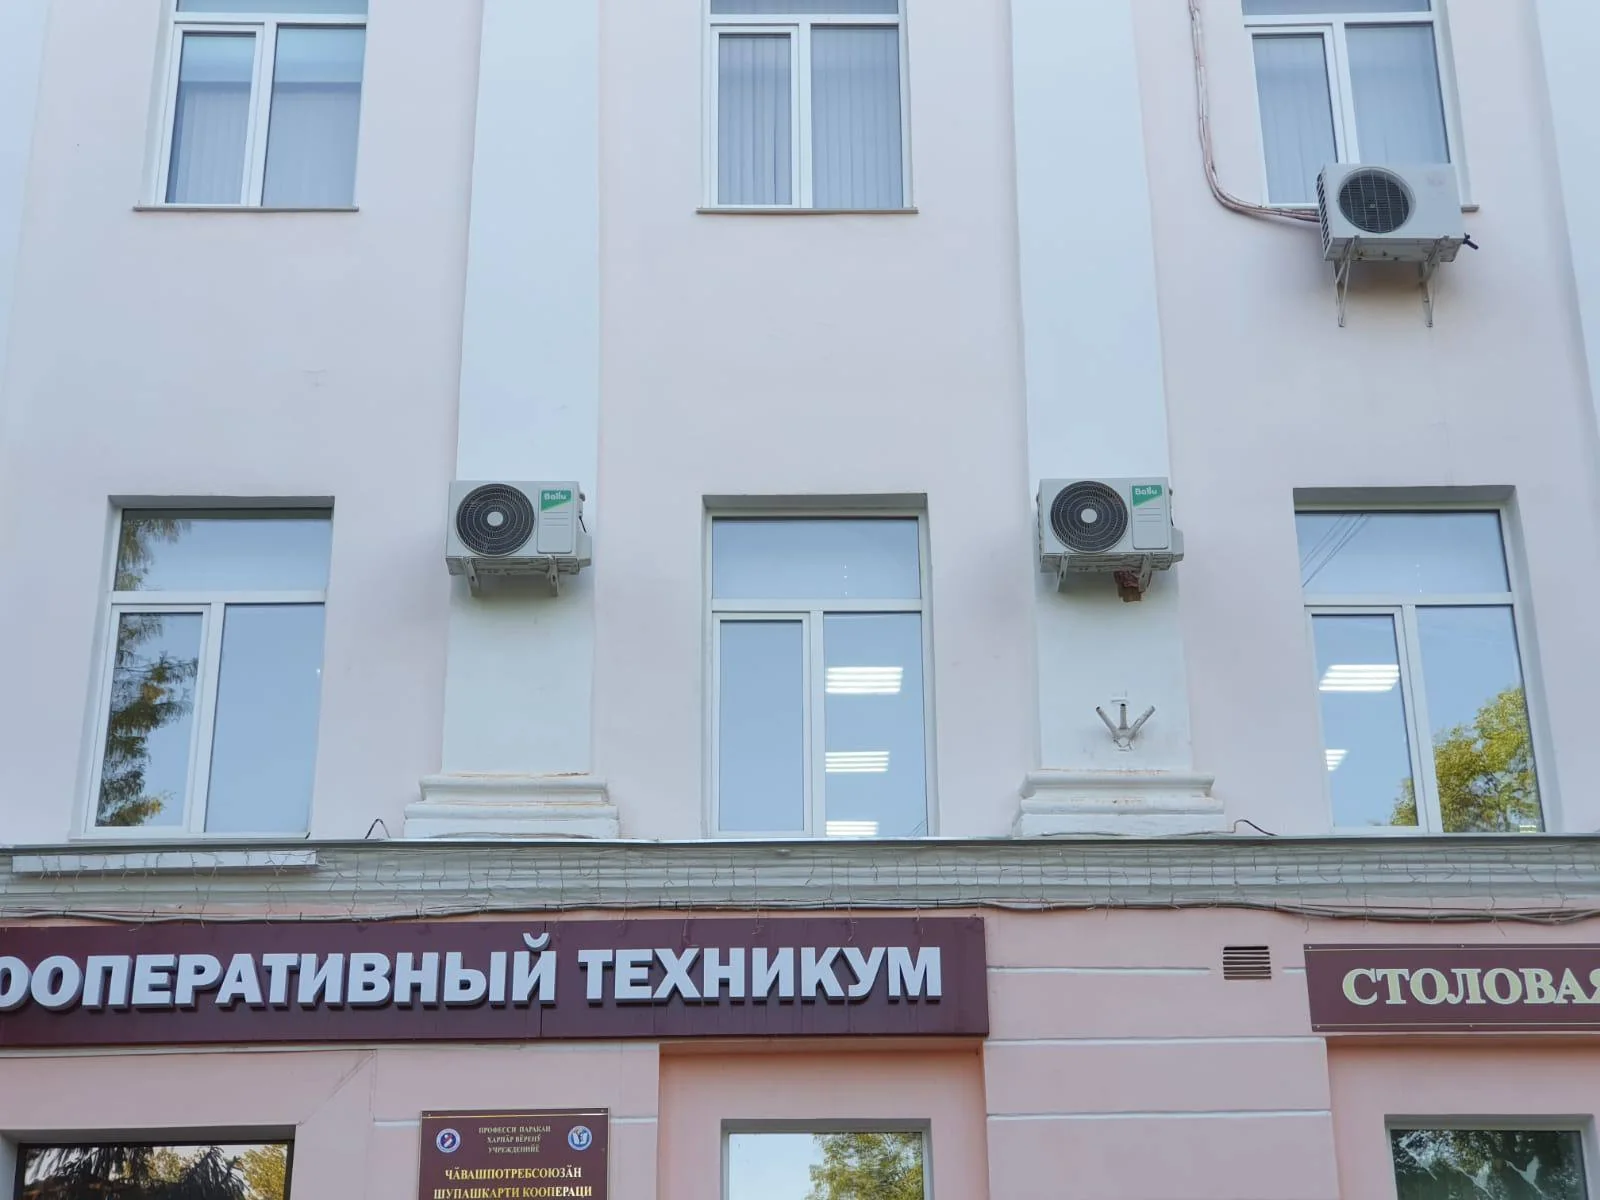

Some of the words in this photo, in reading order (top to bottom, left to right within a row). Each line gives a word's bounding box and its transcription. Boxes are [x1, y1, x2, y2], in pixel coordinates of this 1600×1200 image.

[578, 946, 942, 1004] ТЕХНИКУМ
[479, 1126, 517, 1134] ПРОФЕССИ
[434, 1187, 520, 1200] ШУПАШКАРТИ
[523, 1185, 592, 1199] КООПЕРАЦИ
